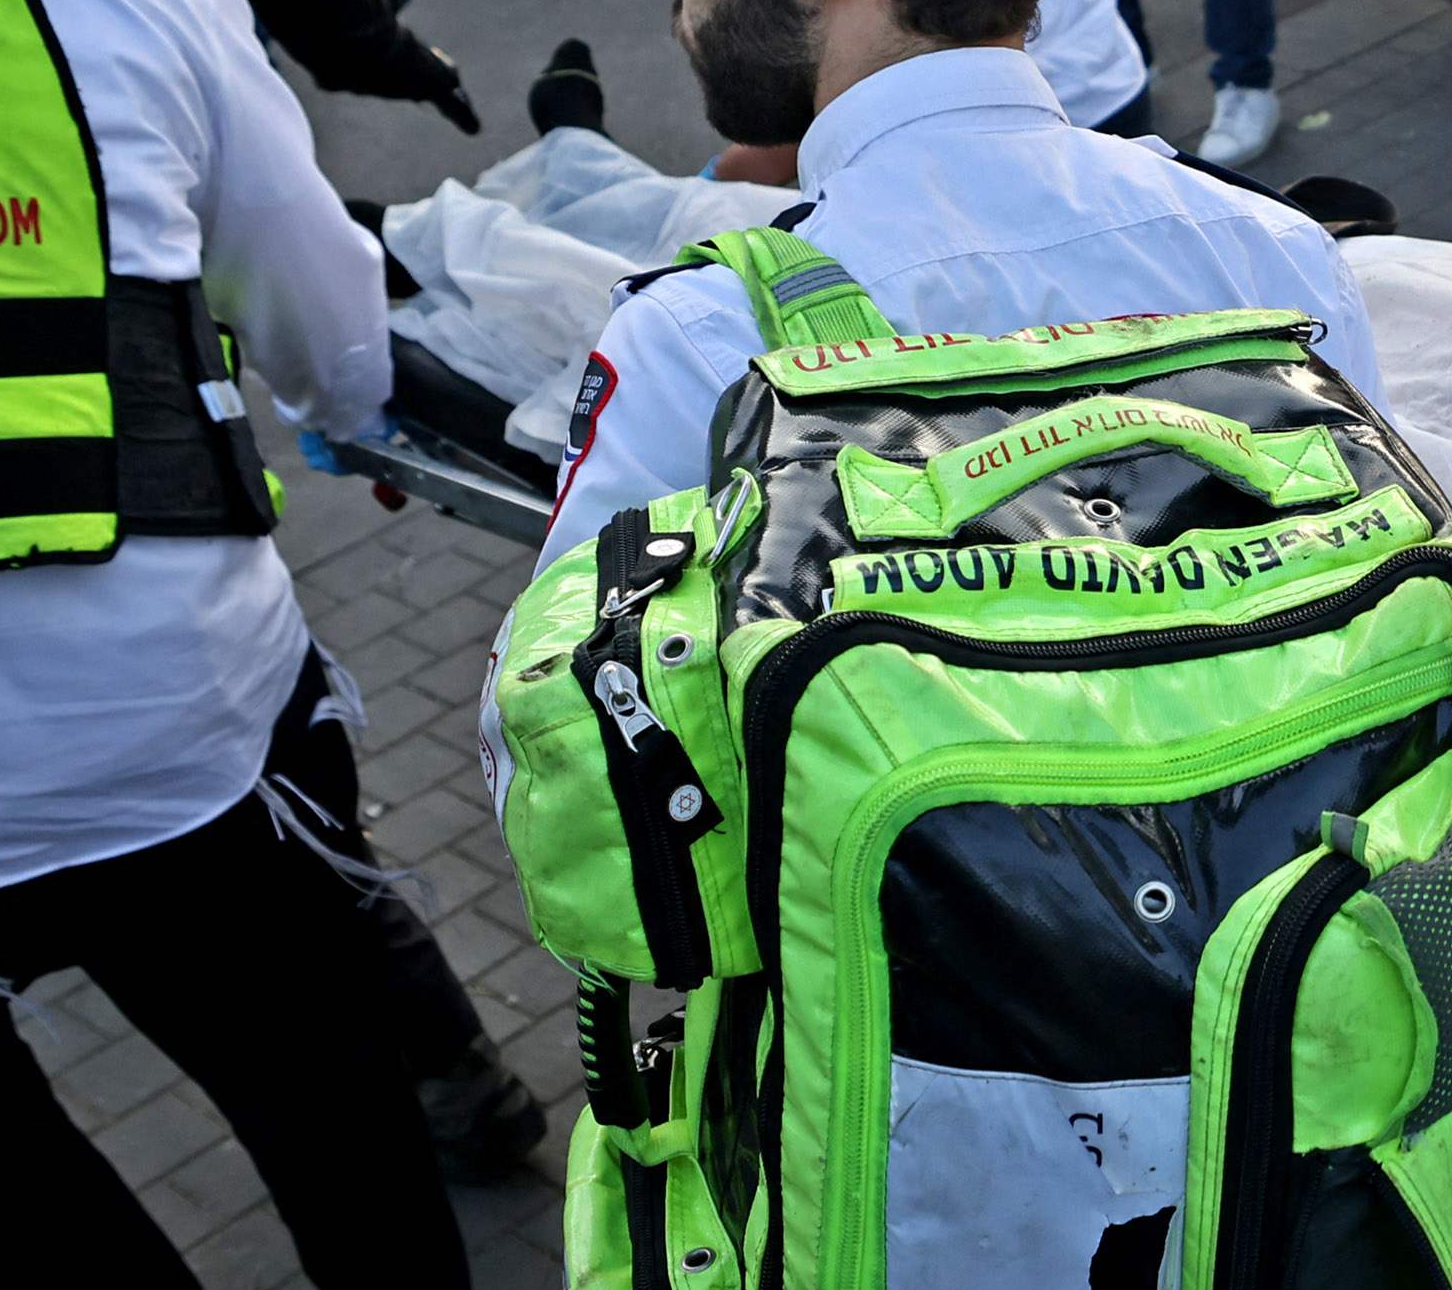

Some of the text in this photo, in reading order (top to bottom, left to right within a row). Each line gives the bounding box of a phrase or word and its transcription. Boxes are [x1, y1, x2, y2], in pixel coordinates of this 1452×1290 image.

[965, 440, 1012, 479] מגן
[1020, 425, 1070, 457] דוד
[1072, 409, 1148, 437] אדום
[856, 546, 1016, 595] ADOM
[1043, 545, 1205, 594] DAVID
